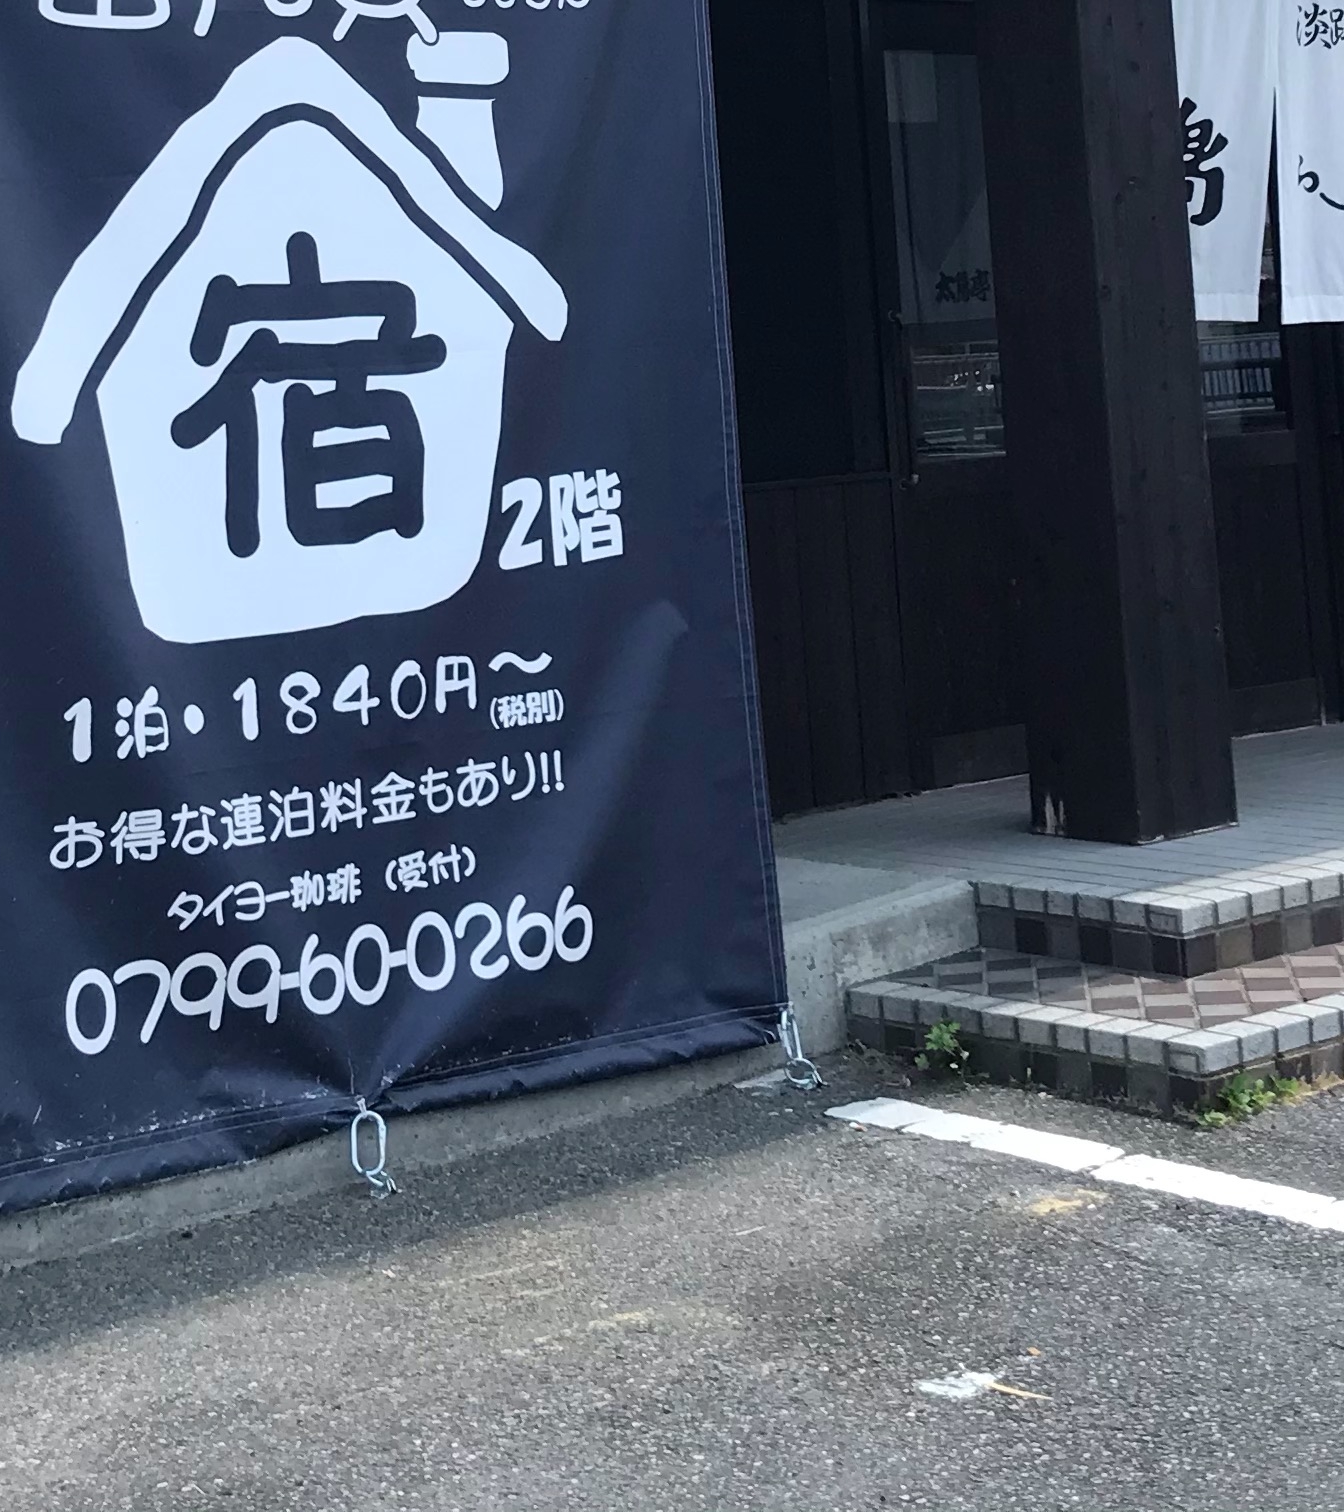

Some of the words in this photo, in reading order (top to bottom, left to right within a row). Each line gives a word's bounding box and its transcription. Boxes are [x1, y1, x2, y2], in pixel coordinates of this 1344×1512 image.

[169, 231, 448, 559] 宿
[498, 468, 624, 571] 2階
[489, 688, 564, 730] (税別)
[49, 750, 565, 870] お得な連泊料金もあり!!
[166, 862, 362, 931] タイヨー珈琲
[385, 843, 476, 893] (受付)
[65, 885, 594, 1055] 0799-60-0266
